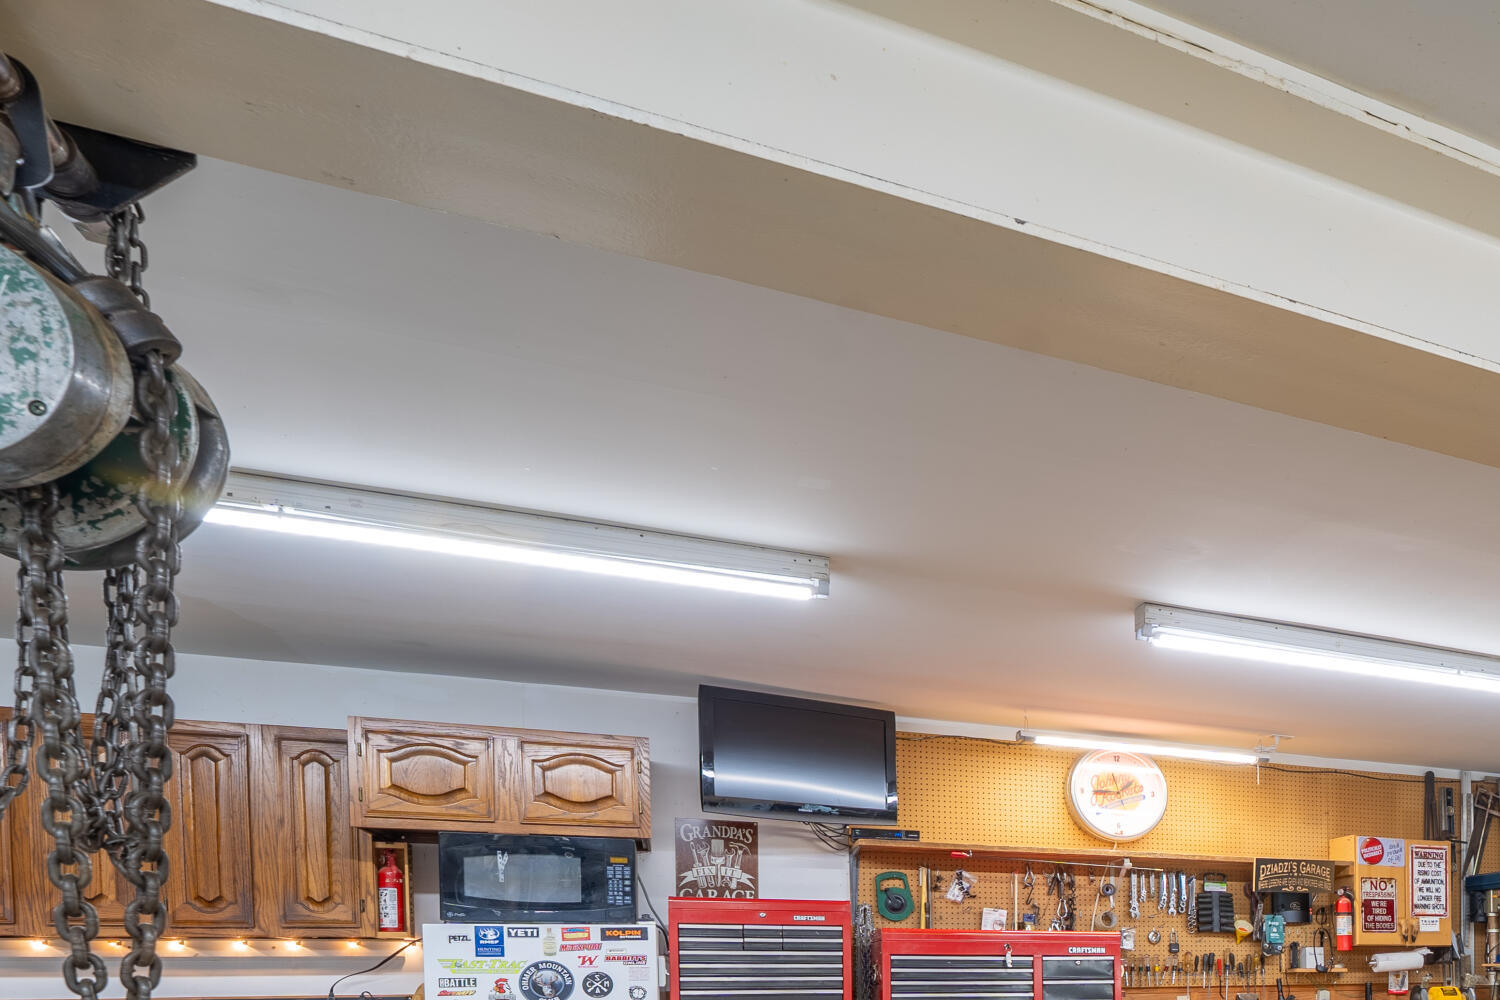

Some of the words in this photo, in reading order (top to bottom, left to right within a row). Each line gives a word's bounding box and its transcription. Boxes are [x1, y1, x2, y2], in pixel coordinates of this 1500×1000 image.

[680, 823, 753, 843] GRANDPA'S
[1414, 851, 1444, 860] WARNING
[694, 867, 714, 876] FIX
[1260, 861, 1297, 877] DZIADZI'S
[1300, 862, 1331, 878] GARAGE
[1370, 880, 1387, 890] NO
[509, 929, 537, 937] YETI
[448, 935, 471, 943] PETZL
[522, 966, 537, 991] OHMER
[538, 962, 572, 985] MOUNTAIN
[444, 978, 476, 988] BATTLE
